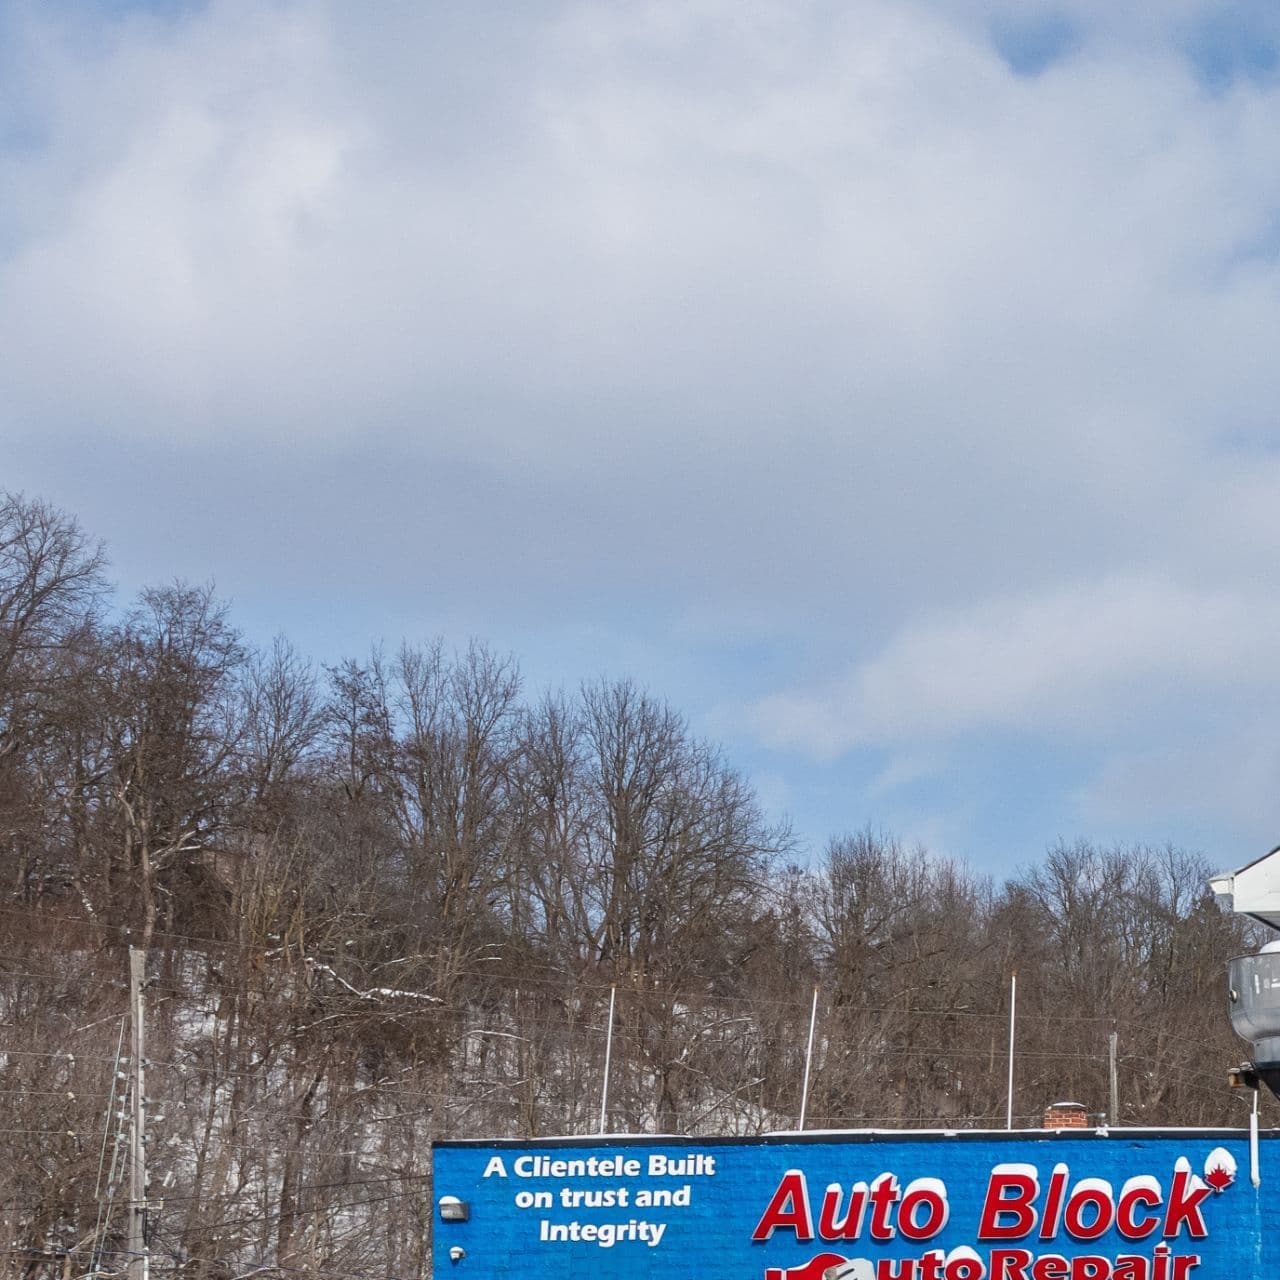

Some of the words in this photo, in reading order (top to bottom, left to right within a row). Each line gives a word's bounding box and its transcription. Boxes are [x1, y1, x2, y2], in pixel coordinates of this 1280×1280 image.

[483, 1156, 507, 1178] A
[514, 1155, 640, 1178] Clientele
[648, 1154, 716, 1176] Built
[515, 1190, 552, 1208] on
[560, 1187, 628, 1208] trust
[634, 1185, 691, 1207] and
[752, 1169, 949, 1241] Auto
[978, 1160, 1213, 1240] Block
[540, 1219, 667, 1248] Integrity
